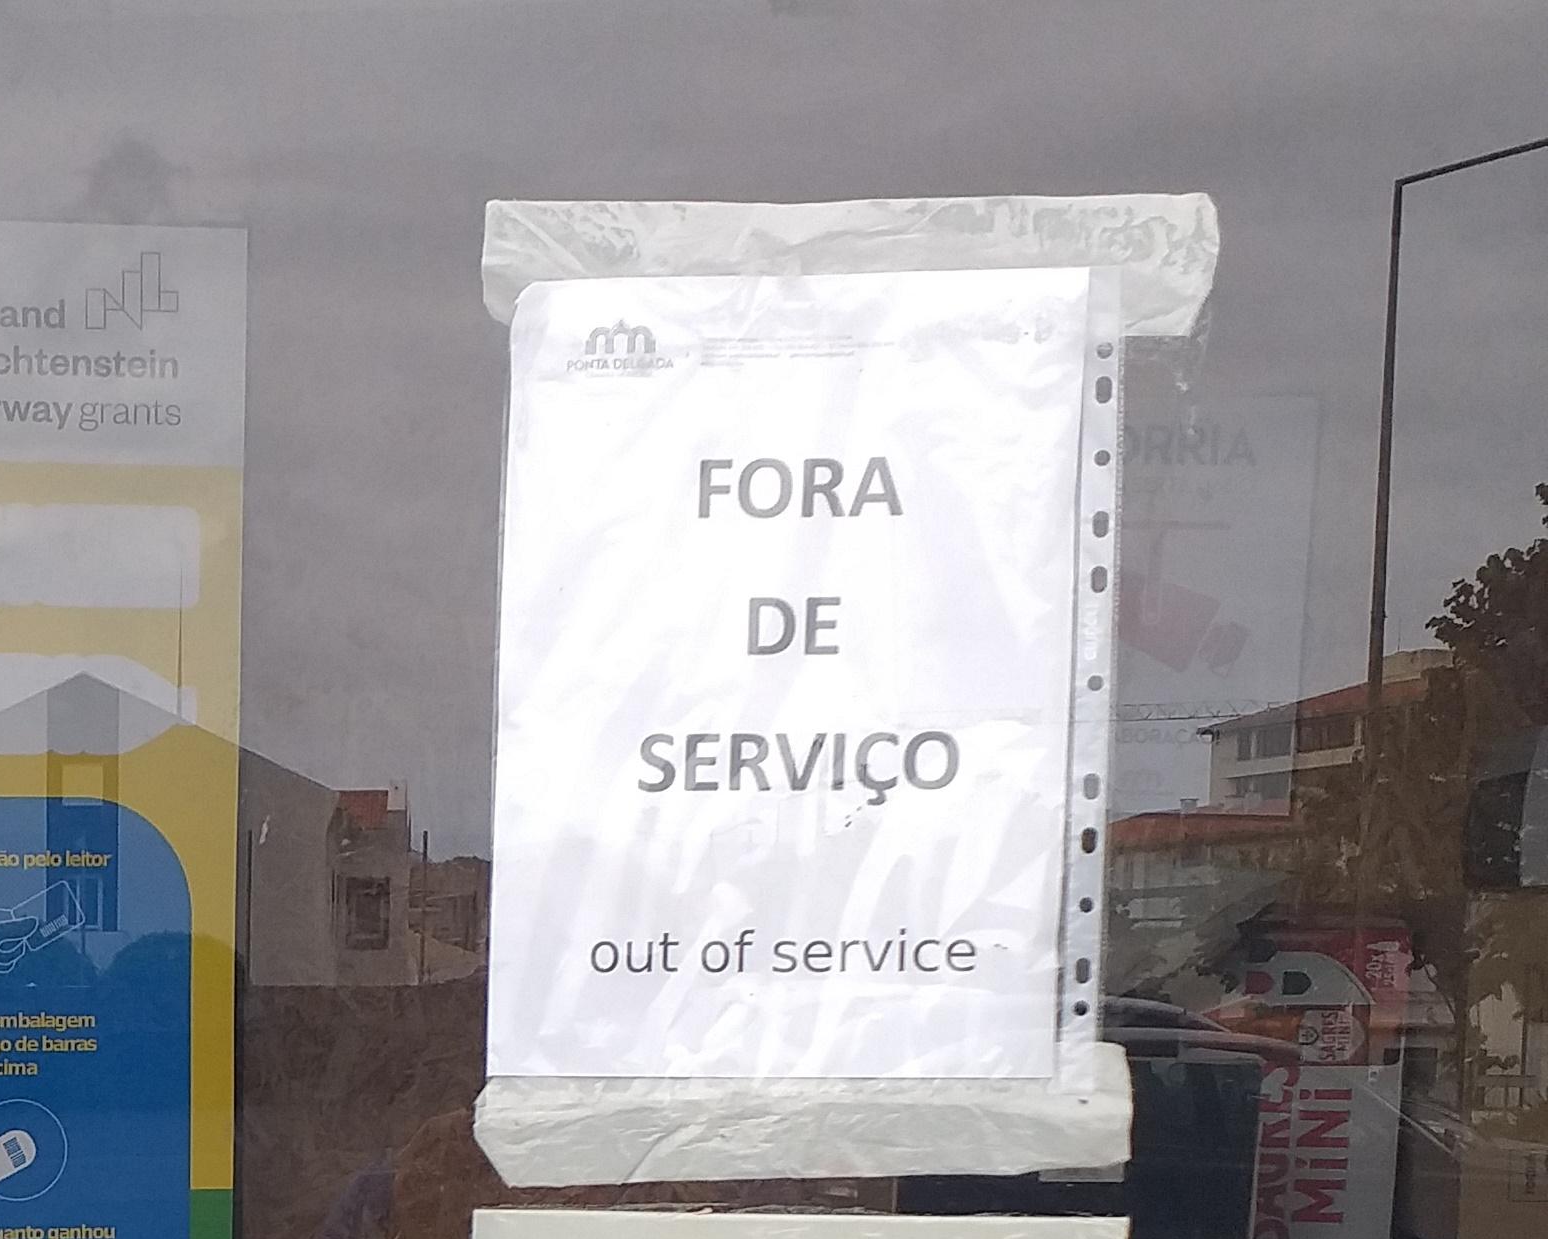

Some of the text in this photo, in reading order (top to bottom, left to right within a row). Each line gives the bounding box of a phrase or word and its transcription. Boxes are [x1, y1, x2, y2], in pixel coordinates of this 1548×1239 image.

[79, 401, 181, 431] grants
[698, 457, 903, 518] FORA
[748, 597, 842, 655] DE
[638, 731, 960, 806] SERVIÇO
[23, 850, 60, 871] pelo
[65, 850, 112, 867] leitor
[590, 928, 977, 974] out of service
[15, 1036, 38, 1052] de
[42, 1035, 97, 1051] barras
